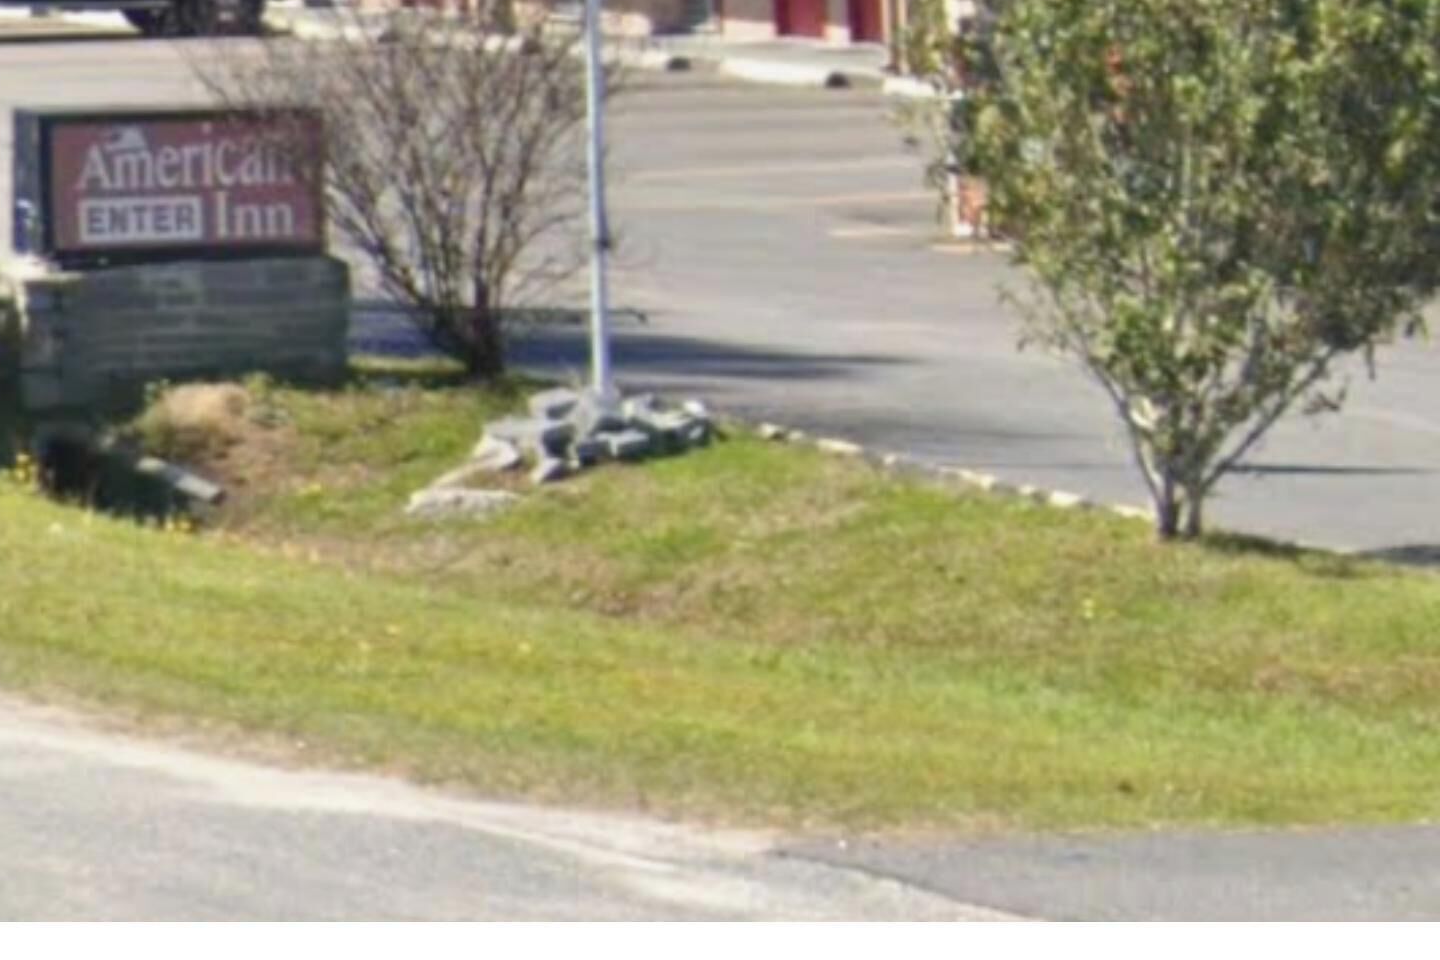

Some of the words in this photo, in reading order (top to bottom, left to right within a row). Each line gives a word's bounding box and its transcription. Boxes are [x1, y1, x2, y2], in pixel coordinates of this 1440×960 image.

[75, 123, 295, 190] American
[86, 202, 198, 237] ENTER
[213, 191, 293, 239] Inn
